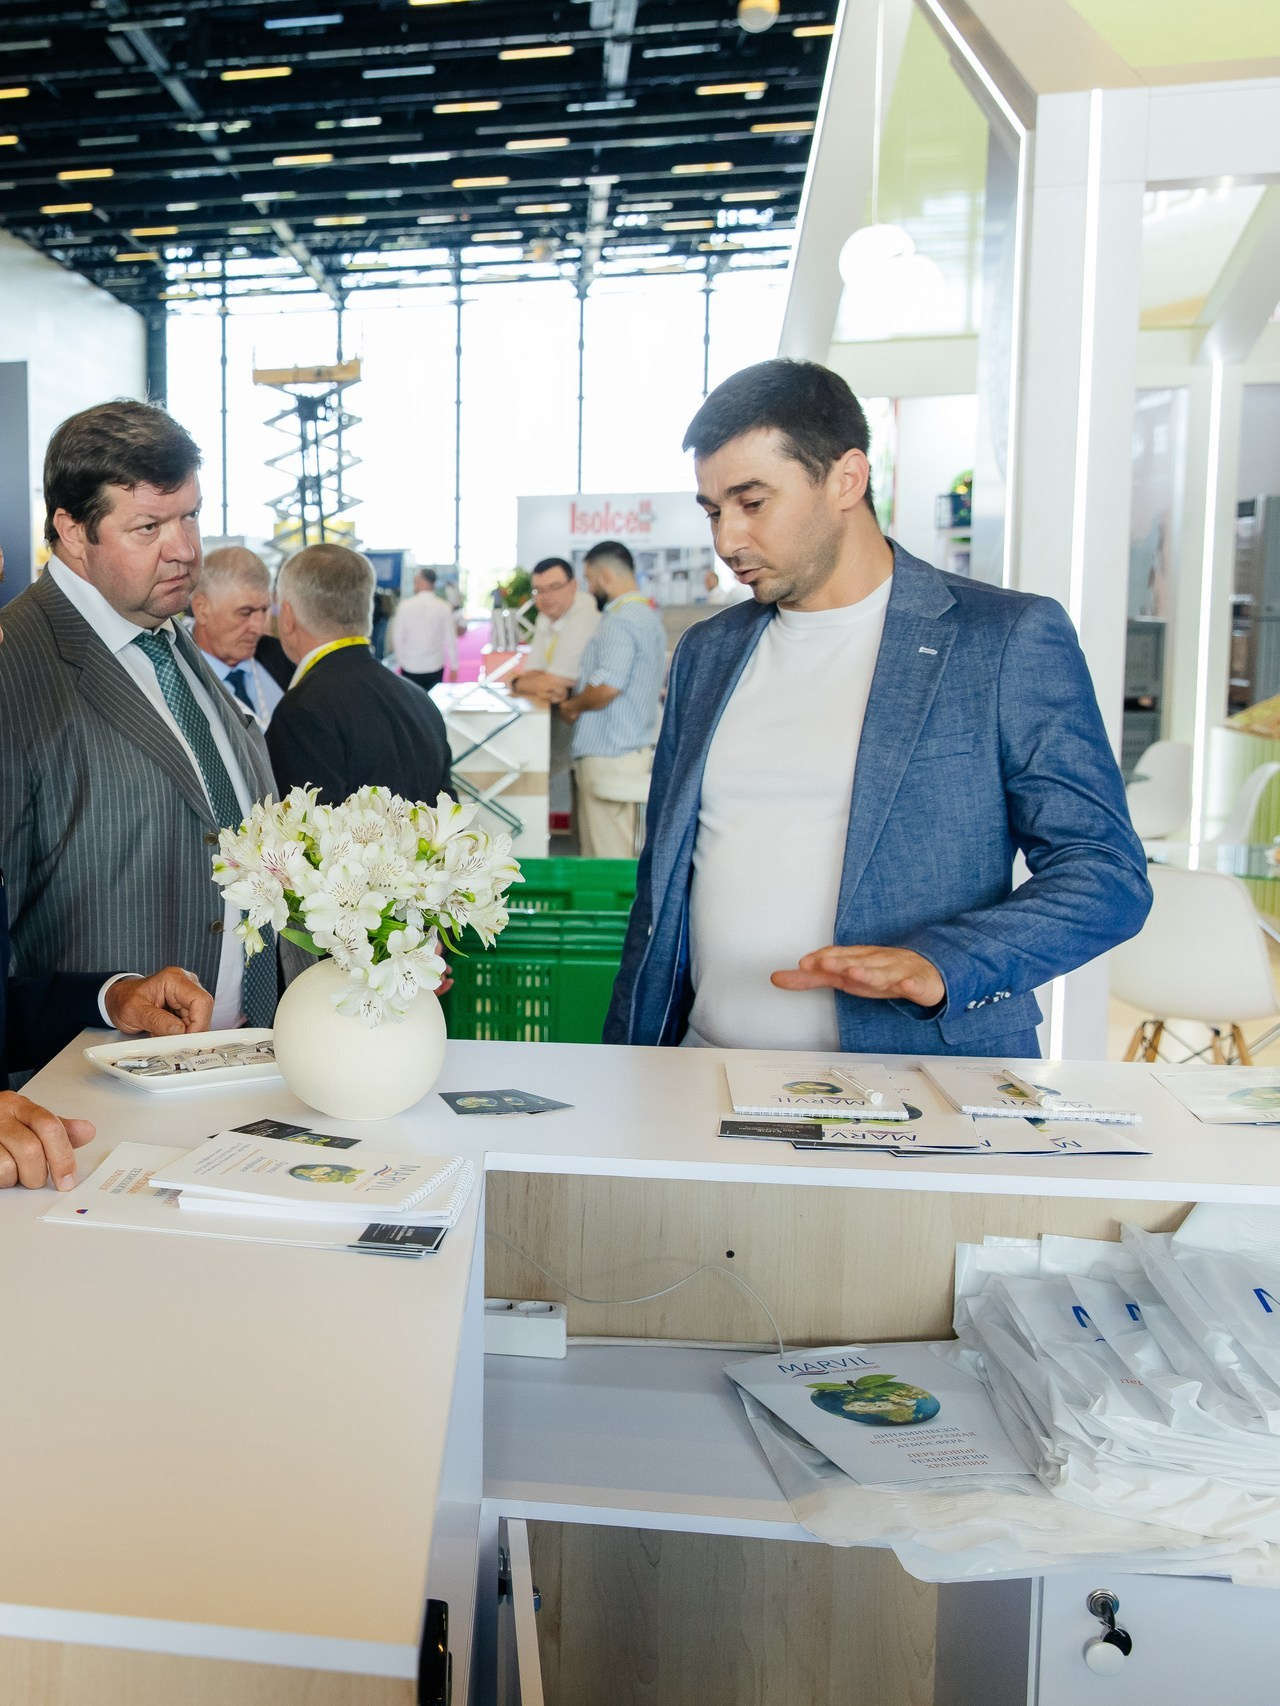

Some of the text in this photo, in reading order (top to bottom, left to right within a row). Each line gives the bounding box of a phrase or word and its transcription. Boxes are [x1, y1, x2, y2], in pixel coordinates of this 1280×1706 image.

[778, 1356, 875, 1374] MARVIL
[870, 1432, 977, 1446] КОНТРОЛИРУЕМАЯ
[873, 1427, 959, 1440] ДИНАМИЧЕСКИ
[897, 1439, 965, 1449] АТМОСФЕРА
[907, 1448, 978, 1459] ПЕРЕДОВЫЕ
[910, 1454, 989, 1465] ТЕХНОЛОГИИ
[925, 1460, 989, 1470] ХРАНЕНИЯ
